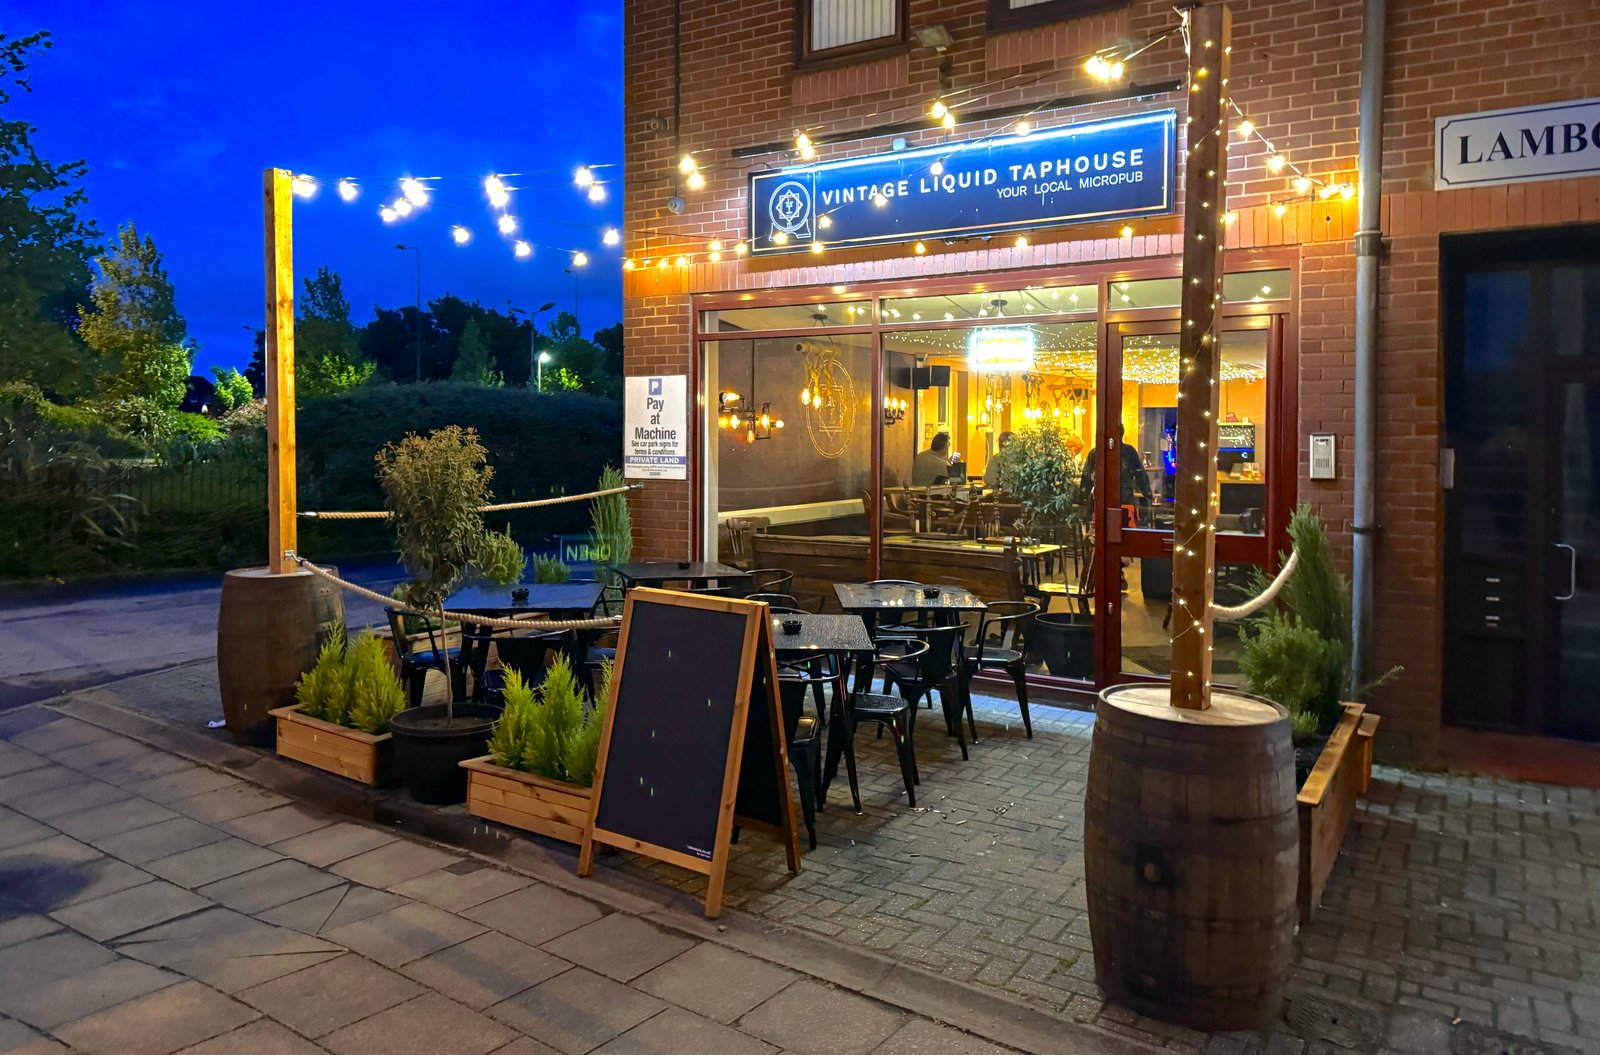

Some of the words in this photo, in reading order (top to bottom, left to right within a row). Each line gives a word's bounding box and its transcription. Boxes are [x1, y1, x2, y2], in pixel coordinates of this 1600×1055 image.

[821, 180, 909, 206] VINTAGE
[920, 168, 997, 194] LIQUID
[1008, 148, 1144, 182] TAPHOUSE
[997, 185, 1028, 199] YOUR
[1034, 179, 1073, 195] LOCAL
[1079, 170, 1144, 190] MICROPUB
[651, 381, 659, 393] P
[646, 397, 664, 412] Pay
[650, 412, 661, 425] at
[634, 427, 677, 440] Machine
[648, 440, 658, 448] park
[659, 440, 671, 448] signs
[629, 456, 659, 464] PRIVATE
